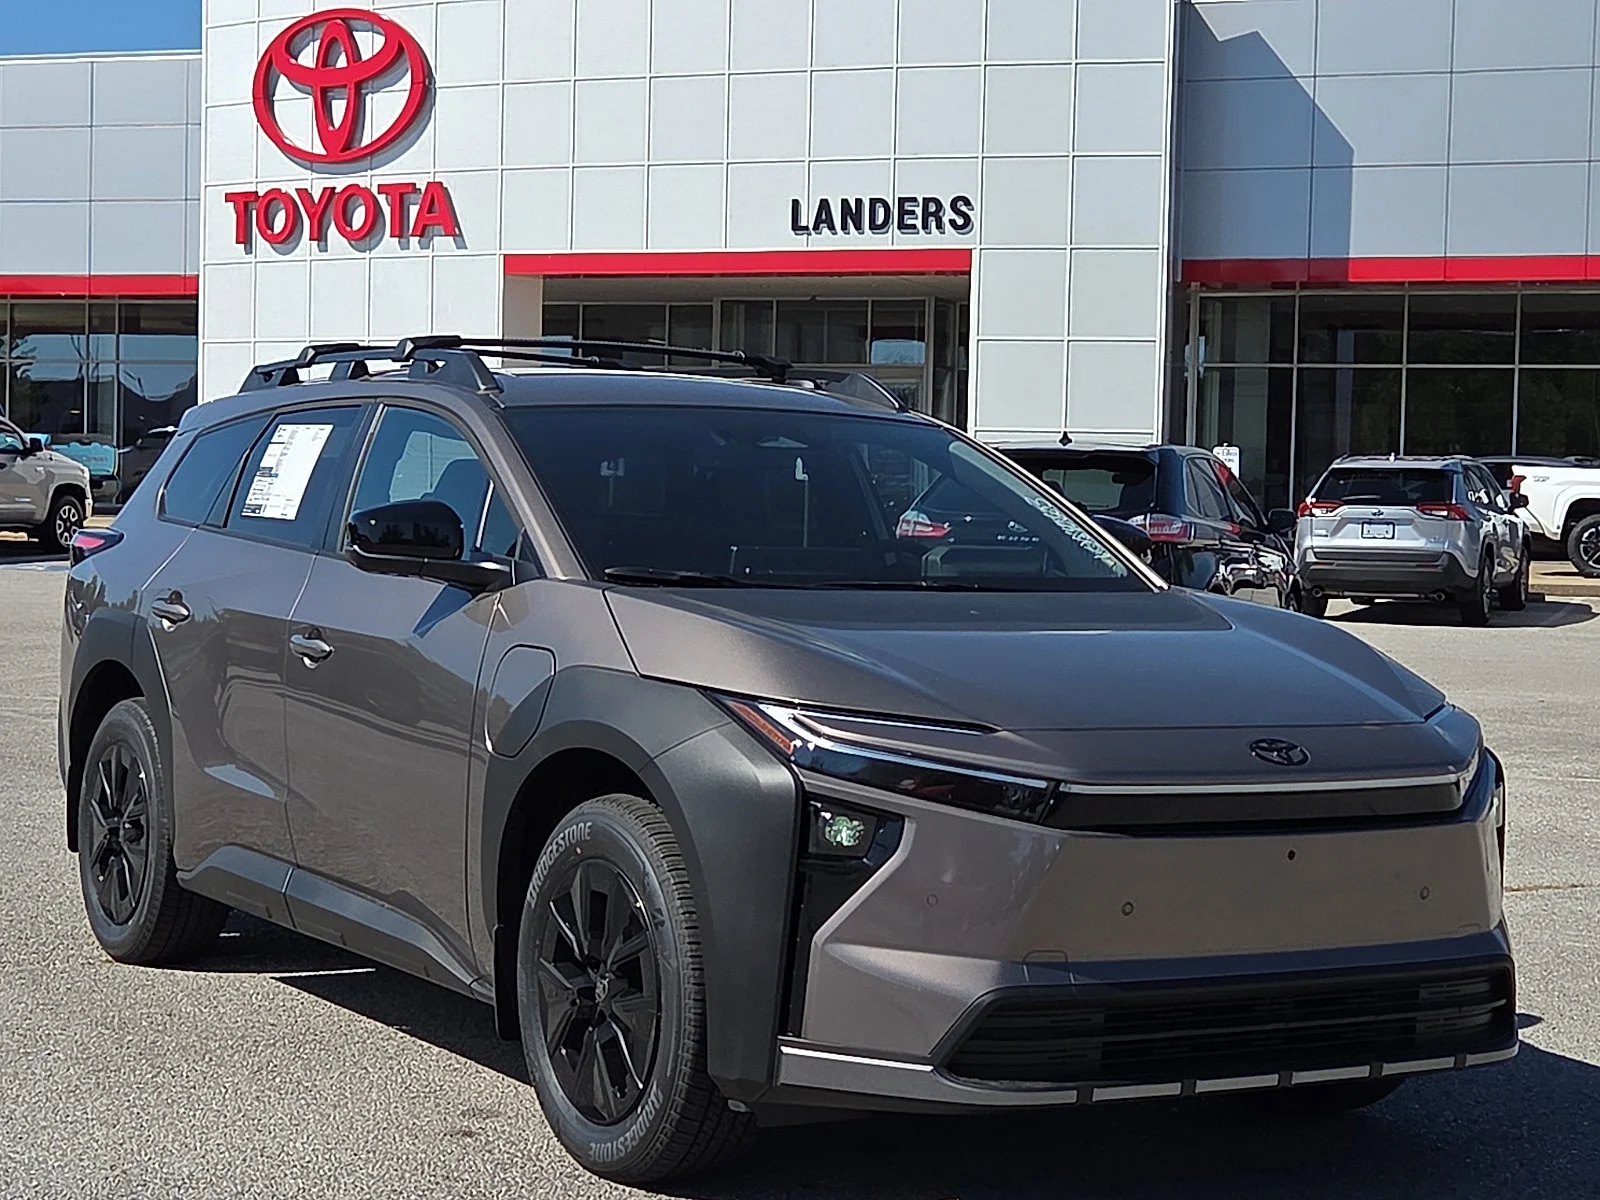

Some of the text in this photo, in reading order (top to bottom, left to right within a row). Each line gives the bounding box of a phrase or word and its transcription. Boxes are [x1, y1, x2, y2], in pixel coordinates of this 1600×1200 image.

[225, 181, 458, 245] TOYOTA
[791, 195, 974, 235] LANDERS
[526, 821, 592, 909] BRIDGESTONE
[588, 1080, 664, 1163] BRIDGESTONE
